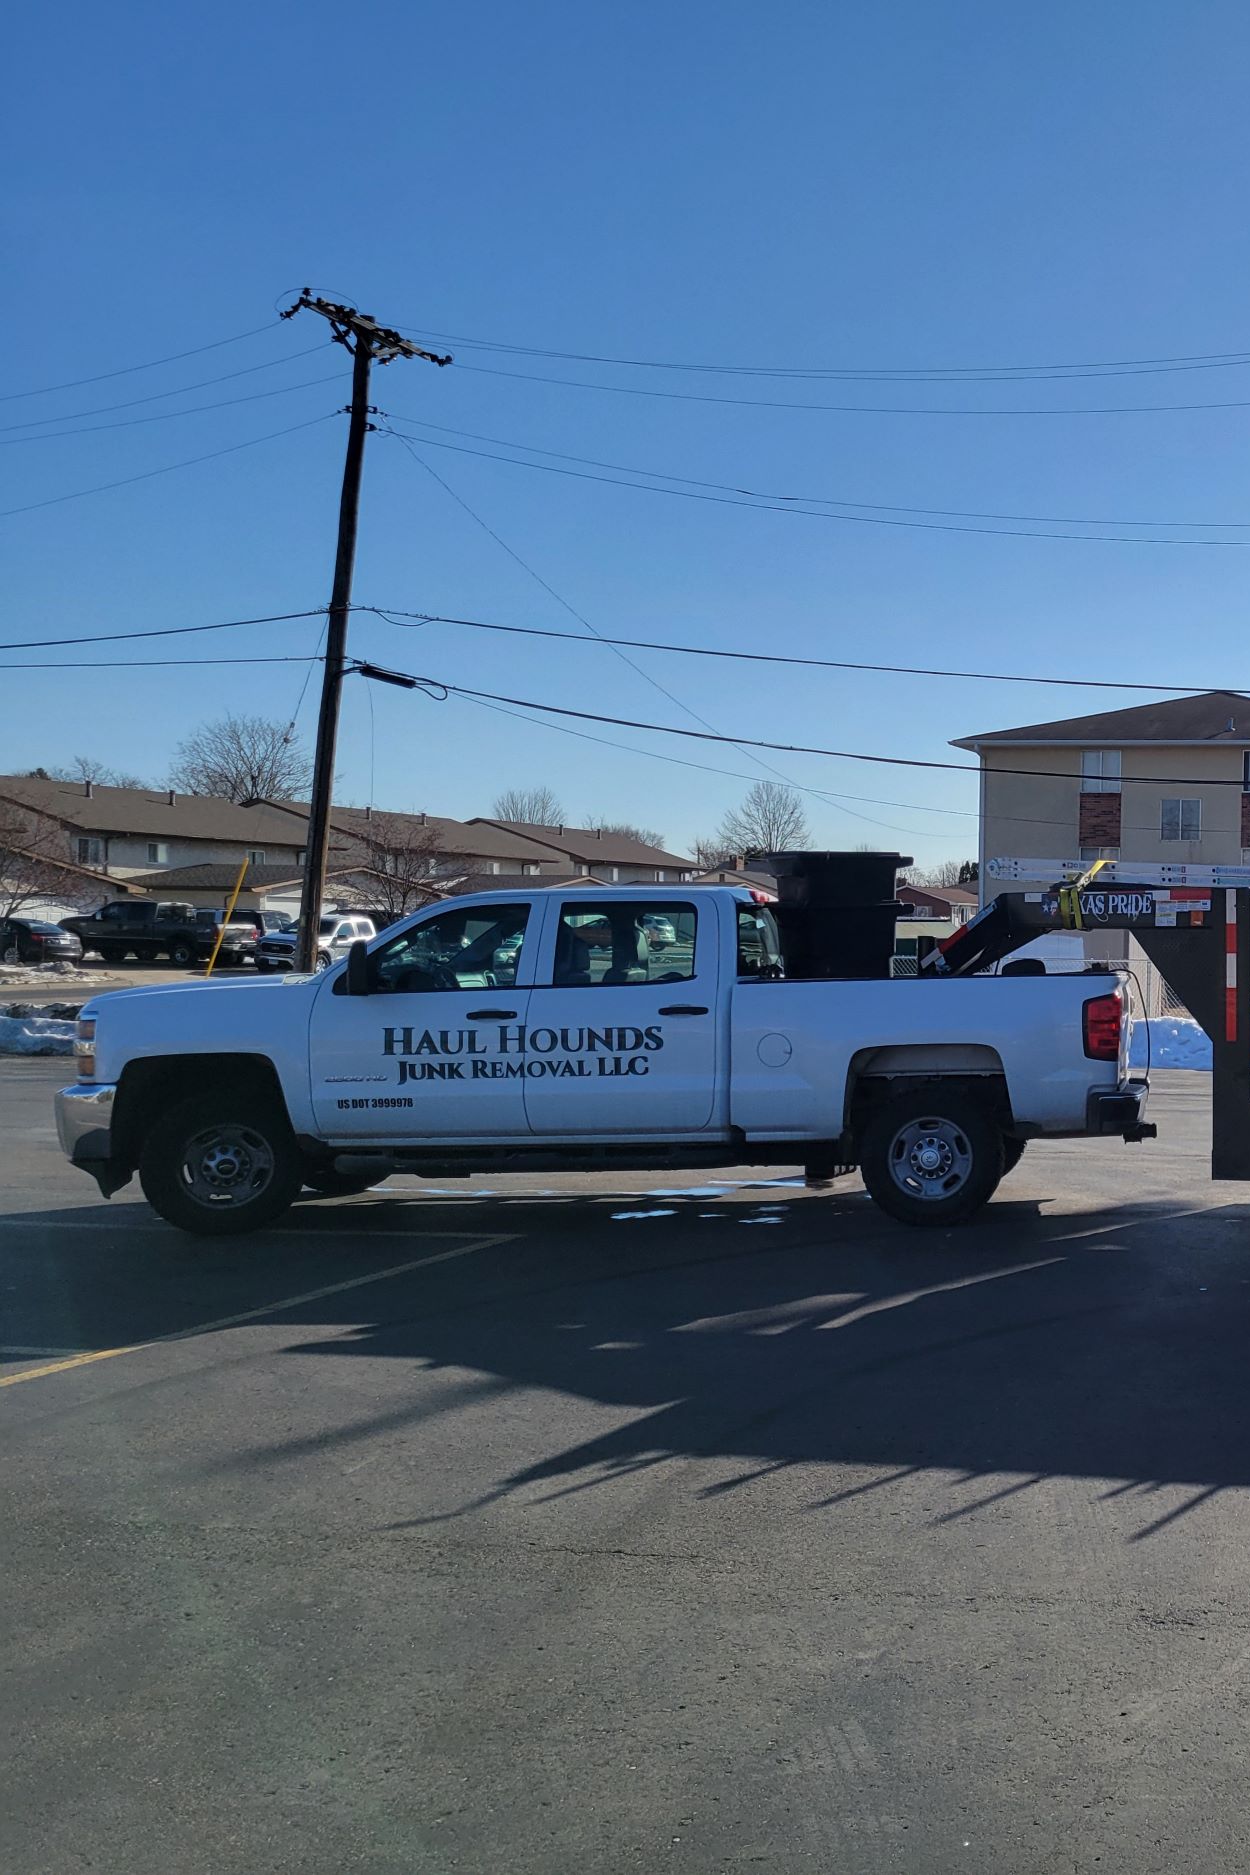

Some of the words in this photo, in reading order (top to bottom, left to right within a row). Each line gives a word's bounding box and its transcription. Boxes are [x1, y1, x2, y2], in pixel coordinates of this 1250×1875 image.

[1108, 894, 1152, 916] PRIDE
[382, 1027, 488, 1056] HAUL
[497, 1025, 665, 1054] HOUNDS
[397, 1060, 466, 1086] JUNK
[471, 1059, 592, 1079] REMOVAL
[596, 1055, 650, 1077] LLC
[337, 1098, 350, 1110] US
[351, 1098, 371, 1109] DOT
[371, 1097, 414, 1108] 3999978
